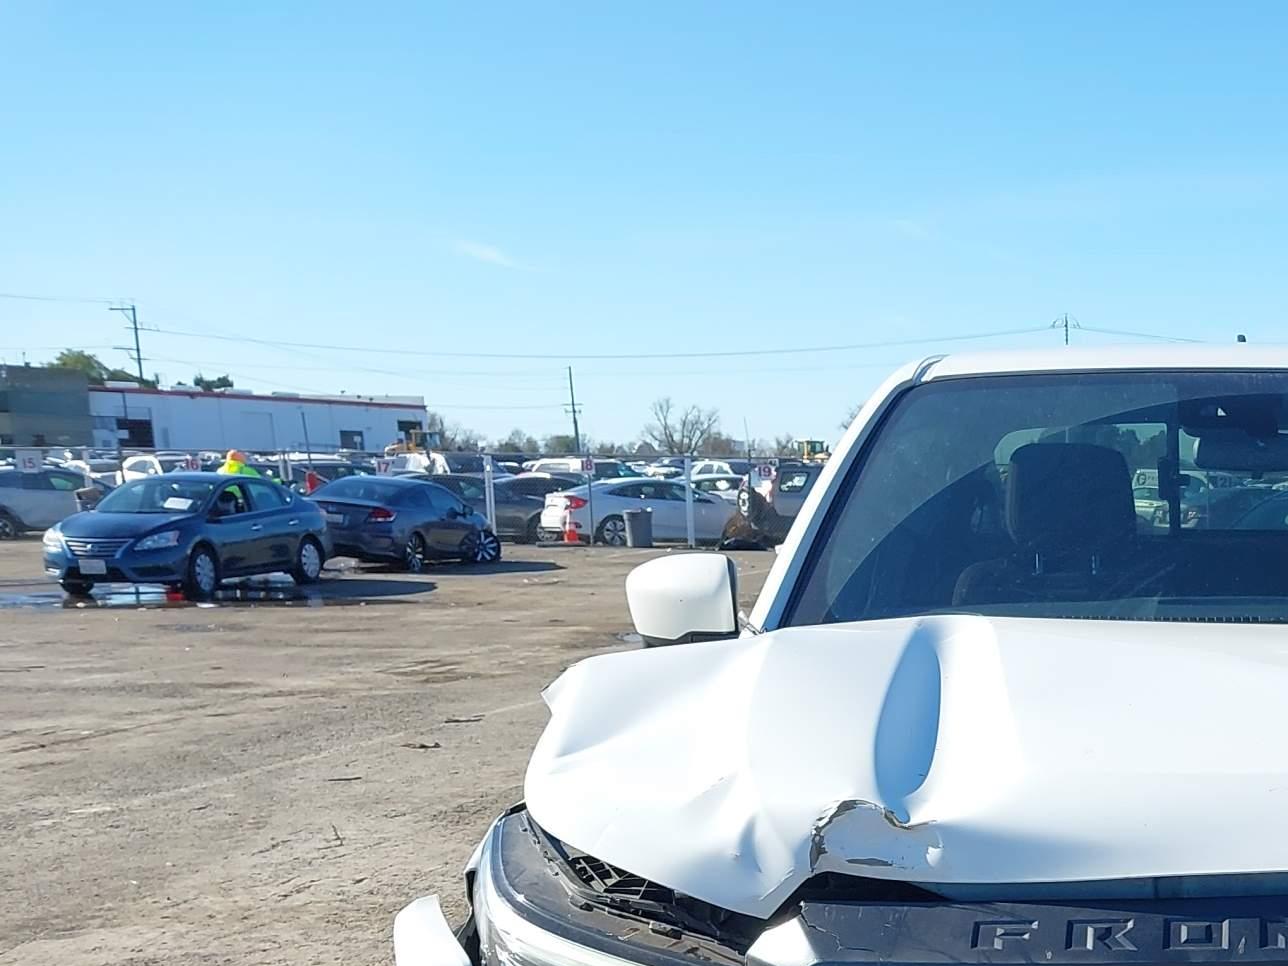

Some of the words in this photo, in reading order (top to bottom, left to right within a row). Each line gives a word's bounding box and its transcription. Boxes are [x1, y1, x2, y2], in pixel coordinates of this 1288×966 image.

[377, 460, 390, 473] 17
[581, 459, 593, 471] 18
[758, 465, 773, 477] 19
